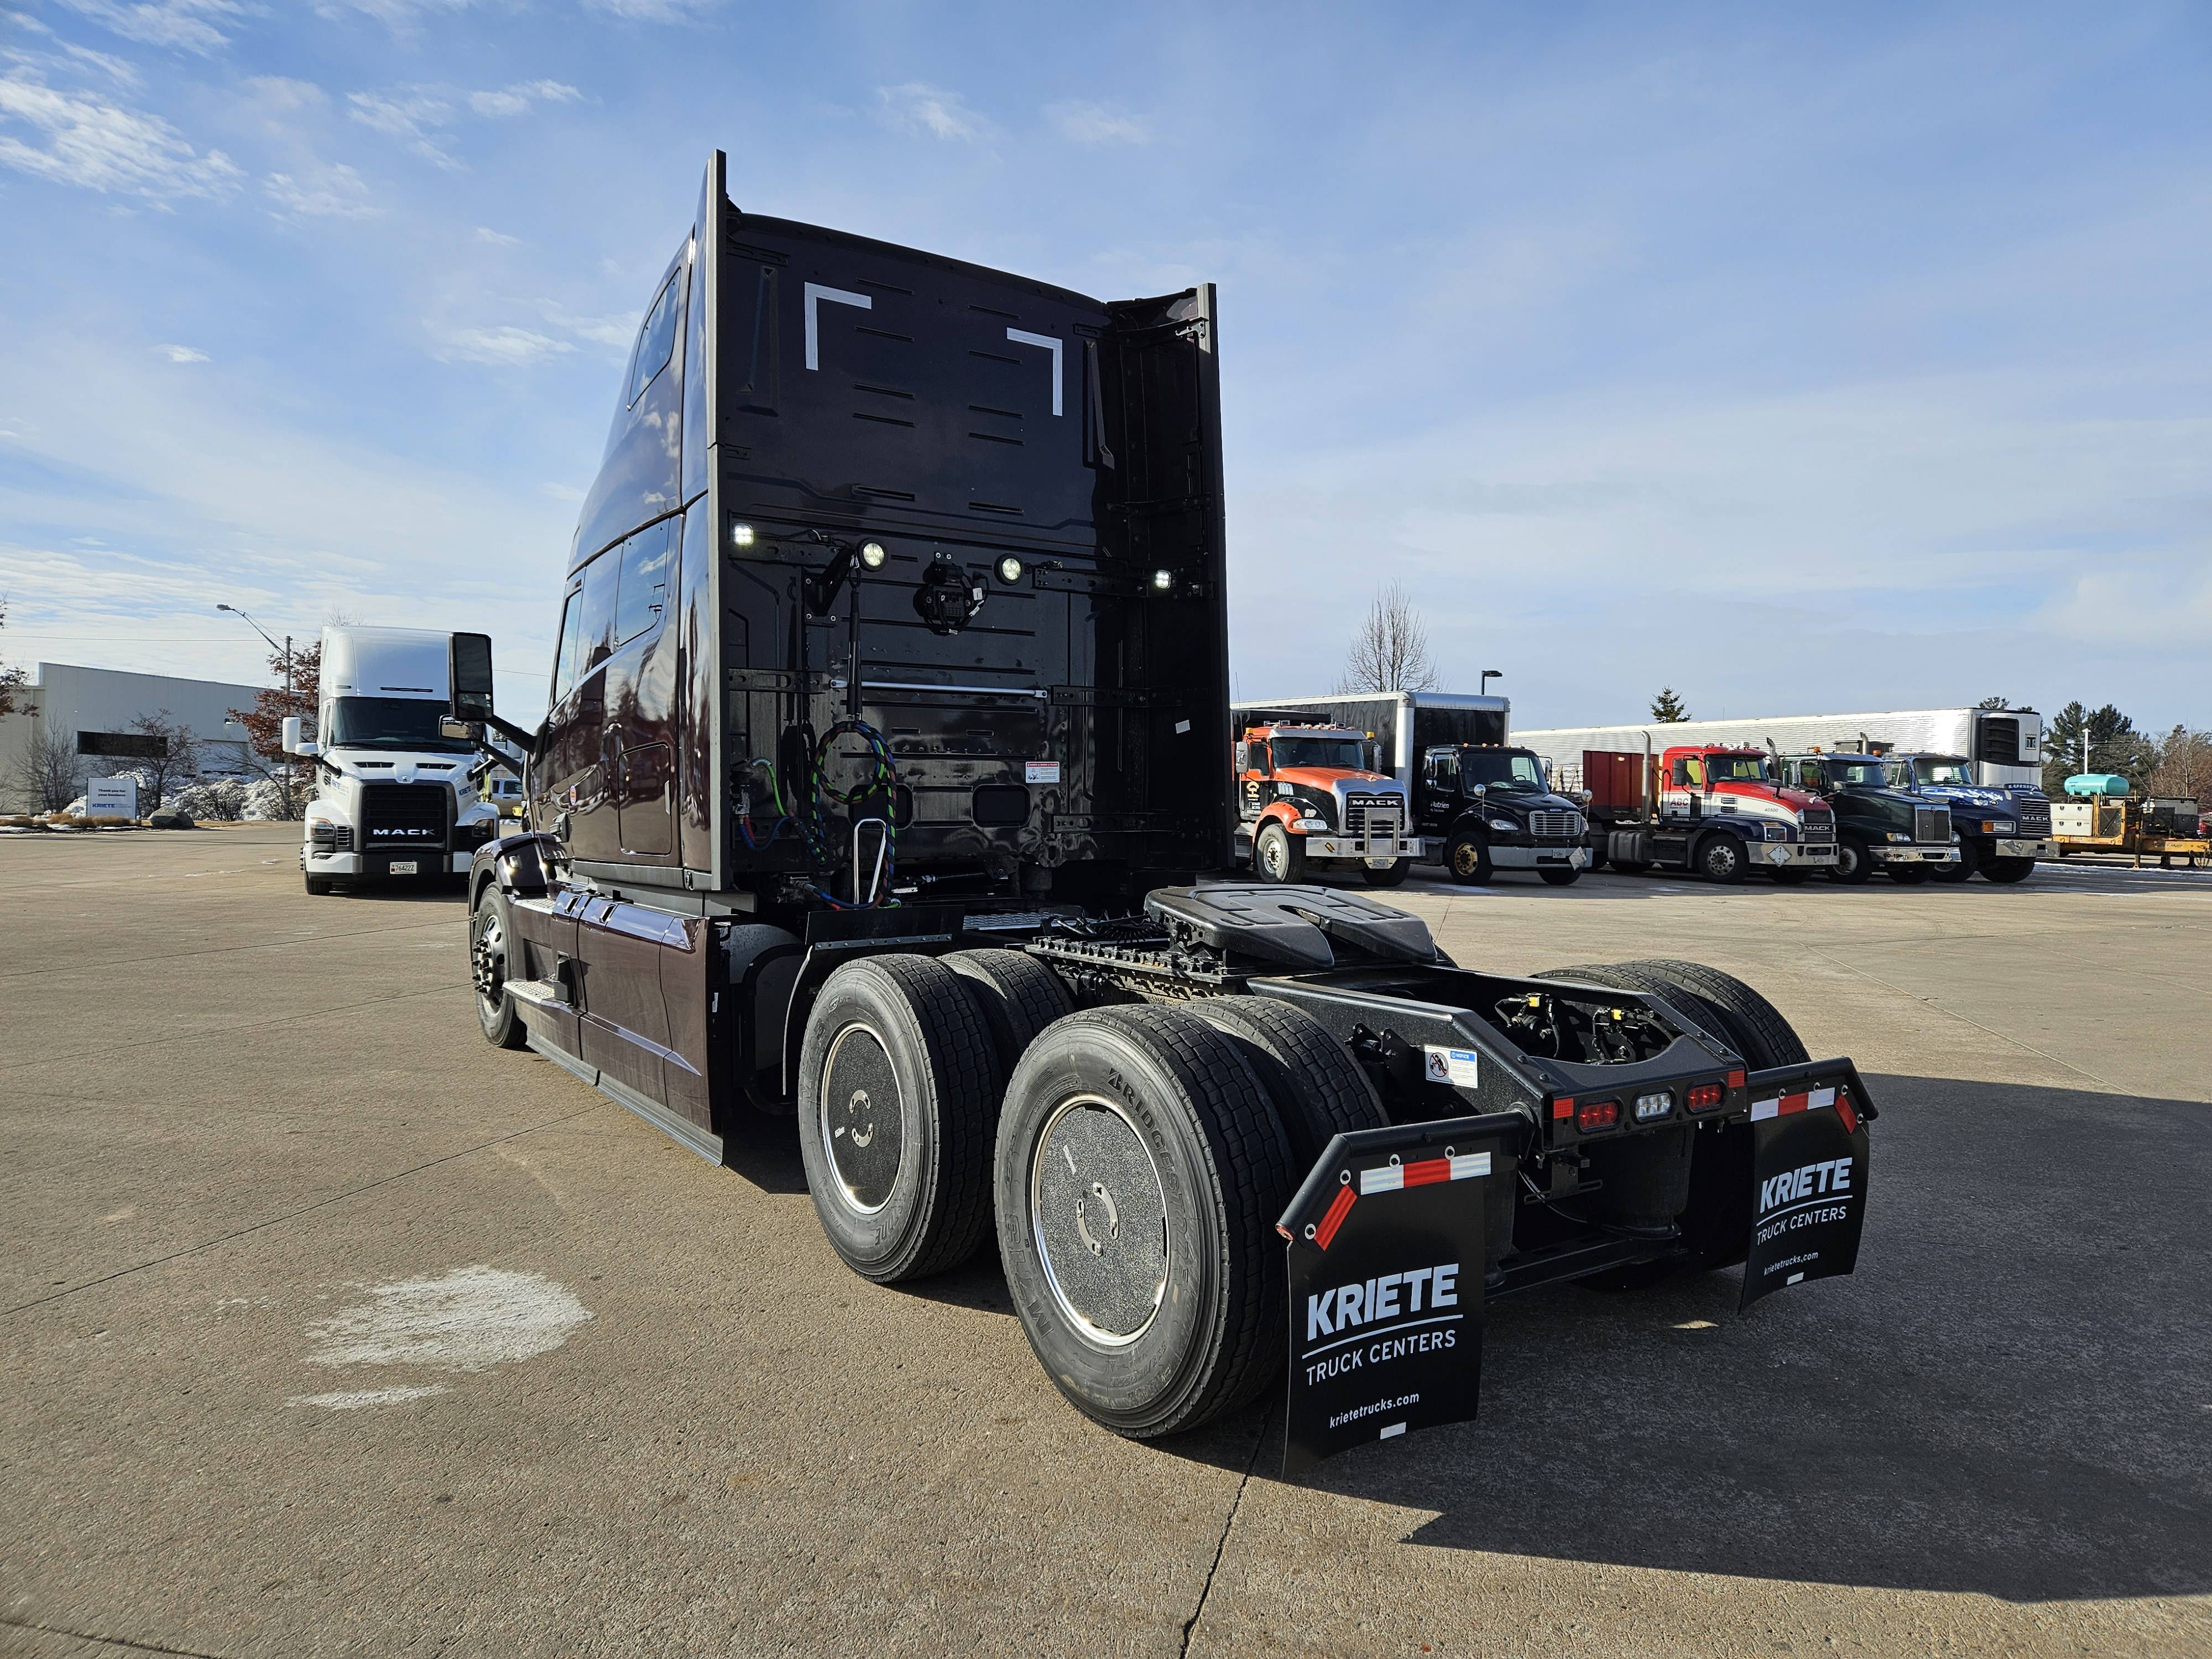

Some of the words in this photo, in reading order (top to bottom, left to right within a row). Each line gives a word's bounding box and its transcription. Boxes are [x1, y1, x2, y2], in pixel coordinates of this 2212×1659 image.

[1670, 798, 1689, 806] ABC
[1107, 1067, 1189, 1282] BRIDGESTONE
[1760, 1157, 1853, 1214] KRIETE
[1756, 1219, 1787, 1246] TRUCK
[1790, 1206, 1846, 1230] CENTERS
[1764, 1252, 1818, 1276] krietetrucks.com
[1307, 1263, 1459, 1341] KRIETE
[1307, 1349, 1363, 1386] TRUCK
[1369, 1329, 1455, 1363] CENTERS
[1329, 1392, 1419, 1428] krietetrucks.com
